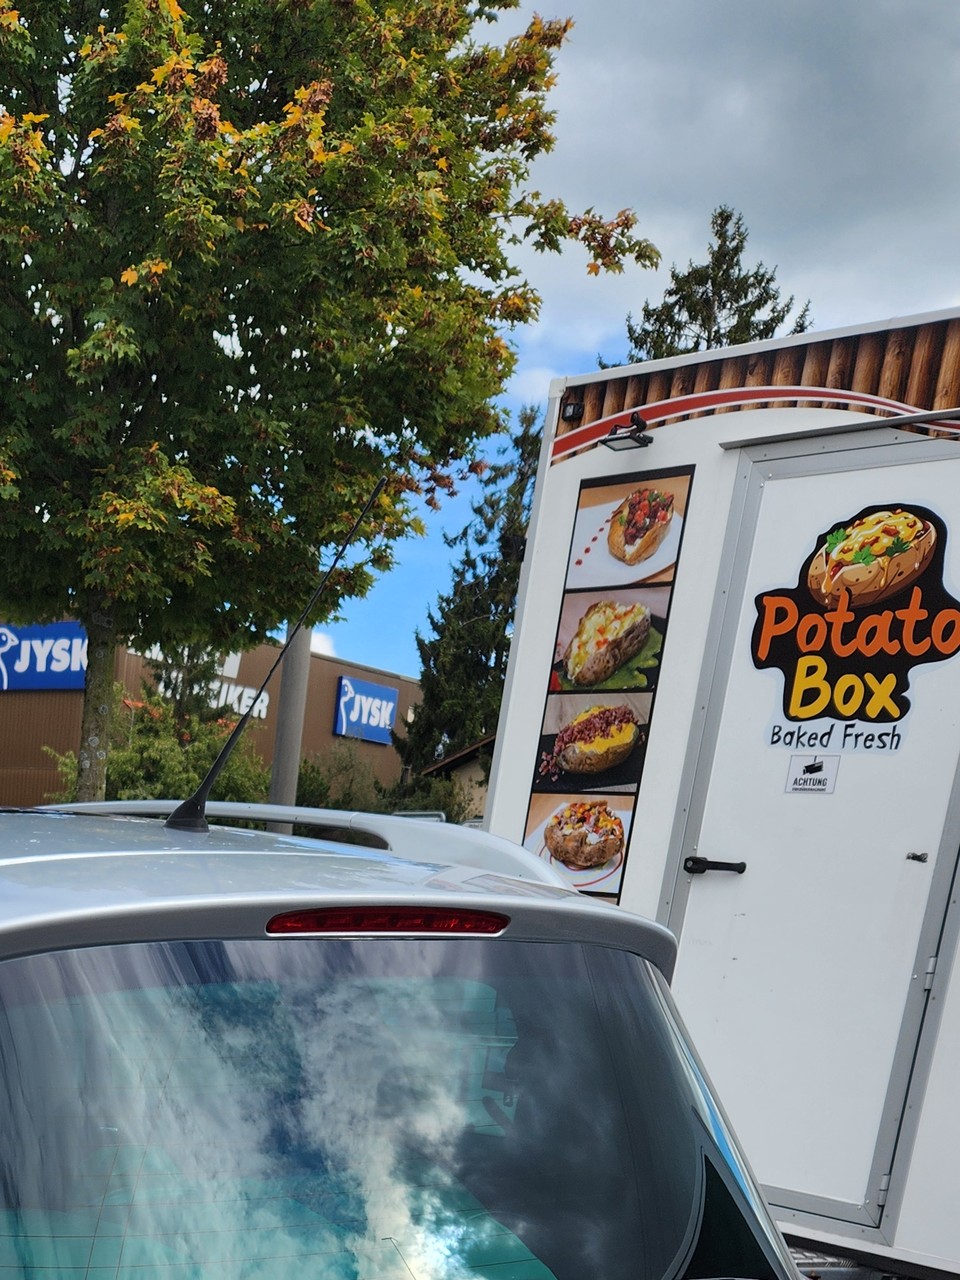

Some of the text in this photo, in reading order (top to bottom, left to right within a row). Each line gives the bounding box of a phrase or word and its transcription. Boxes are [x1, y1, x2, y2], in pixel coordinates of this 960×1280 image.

[757, 586, 960, 661] Potato
[14, 638, 88, 672] JYSK
[789, 655, 901, 718] Box
[350, 694, 394, 729] JYSK
[770, 723, 901, 750] Baked Fresh
[792, 777, 828, 787] ACHTUNG
